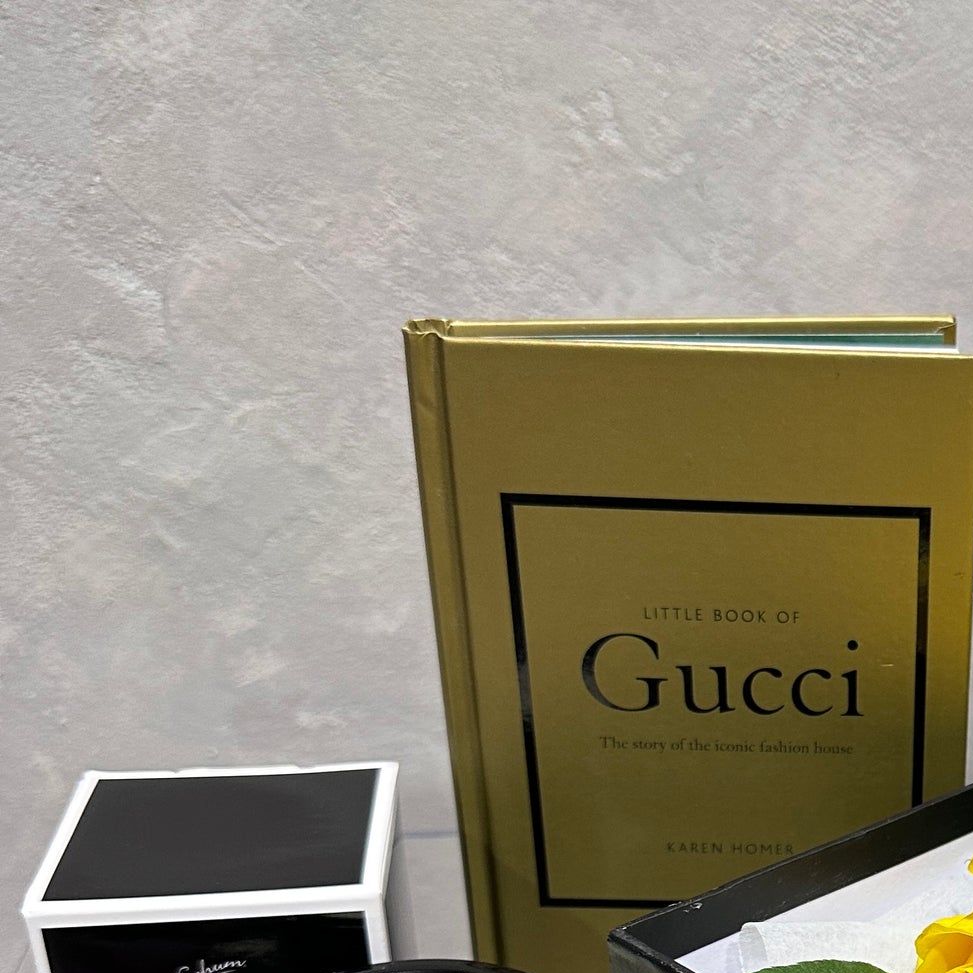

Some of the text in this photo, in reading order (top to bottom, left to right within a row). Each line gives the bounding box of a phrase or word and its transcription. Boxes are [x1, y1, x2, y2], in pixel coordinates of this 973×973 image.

[643, 607, 801, 624] LITTLE BOOK OF
[581, 633, 864, 717] Gucci
[600, 736, 854, 755] The story of the iconic fashion house
[666, 842, 794, 856] KAREN HOMER
